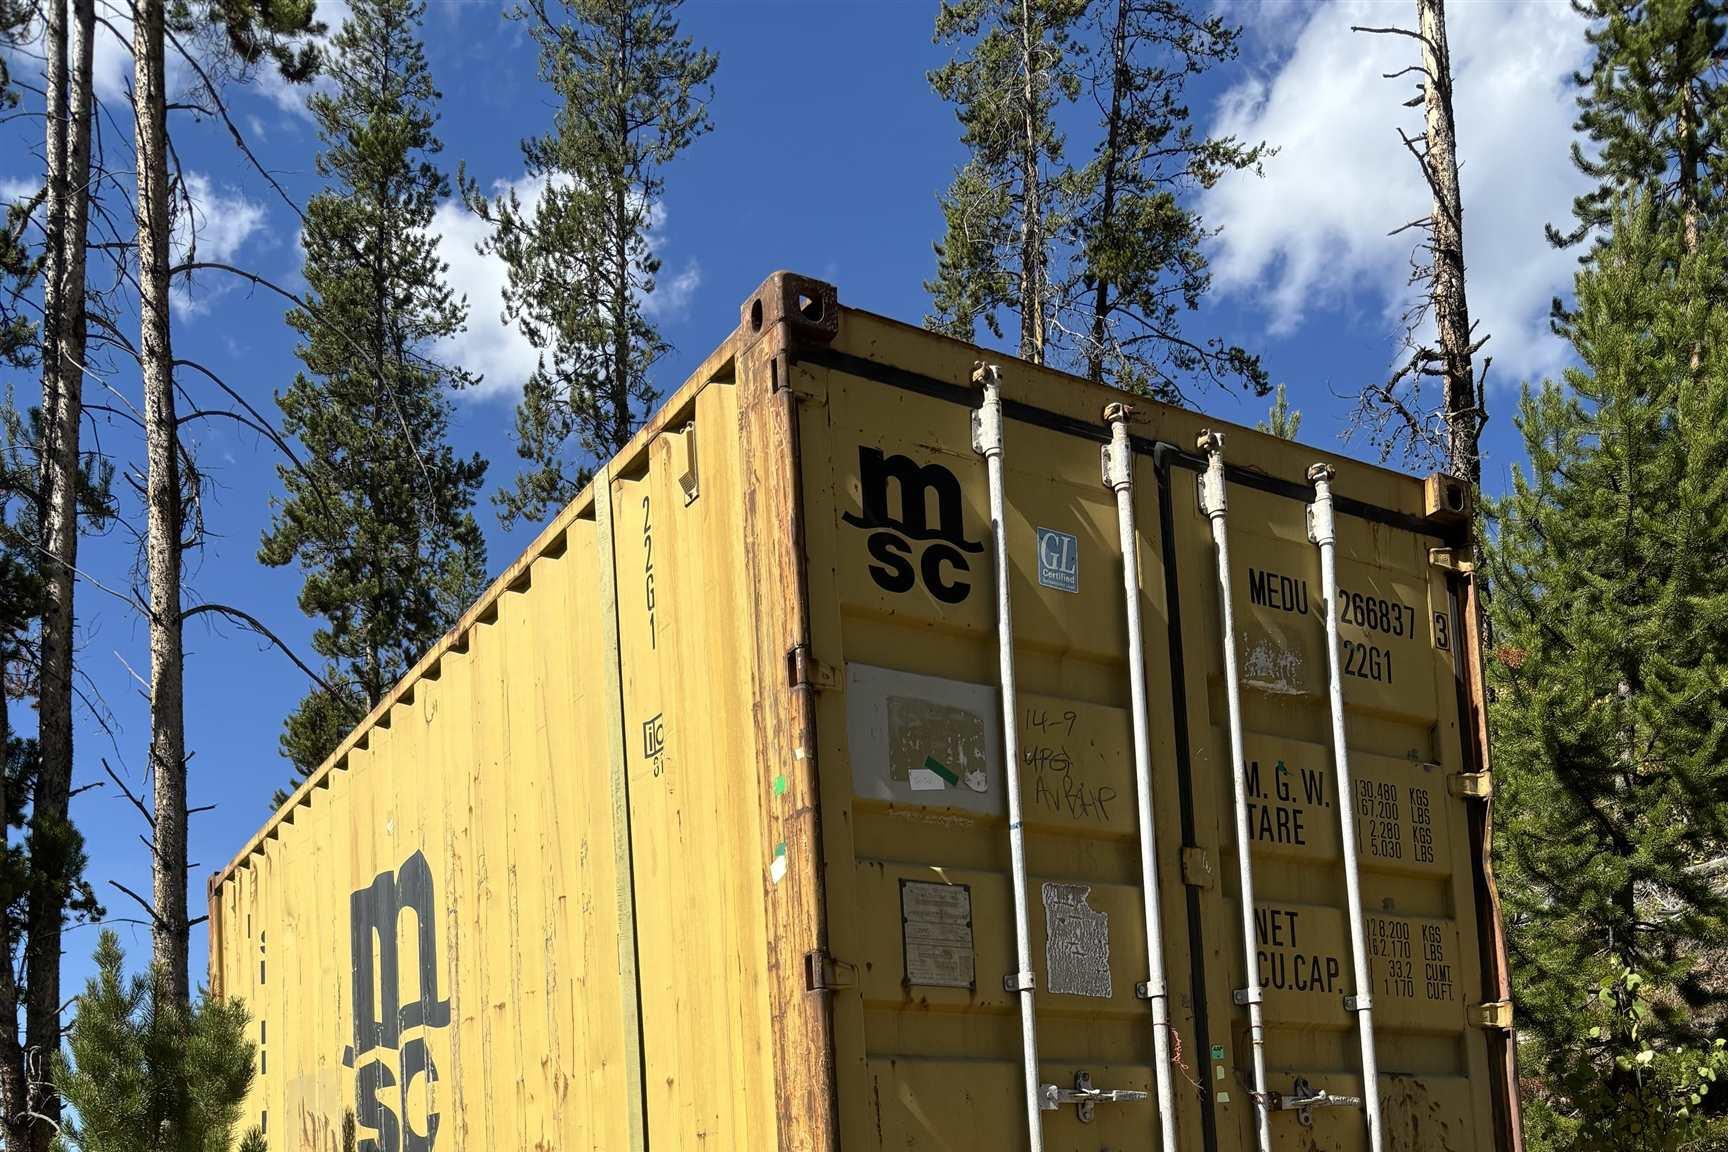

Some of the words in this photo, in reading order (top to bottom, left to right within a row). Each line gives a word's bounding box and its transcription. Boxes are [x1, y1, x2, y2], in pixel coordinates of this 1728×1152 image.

[1041, 533, 1075, 574] GL
[1249, 568, 1308, 615] MEDU
[1338, 589, 1415, 639] 266837
[1434, 613, 1448, 648] 3
[1343, 640, 1392, 684] 22G1
[1360, 779, 1398, 801] 30.480
[1409, 787, 1430, 807] KGS
[1246, 803, 1306, 845] TARE
[1361, 799, 1399, 820] 67.200
[1410, 807, 1431, 826] LBS
[1369, 819, 1401, 840] 2.280
[1412, 826, 1433, 845] KGS
[1414, 844, 1434, 864] LBS
[1253, 908, 1298, 948] NET
[1422, 924, 1442, 944] KGS
[1423, 943, 1443, 963] LBS
[1388, 960, 1413, 979] 33.2
